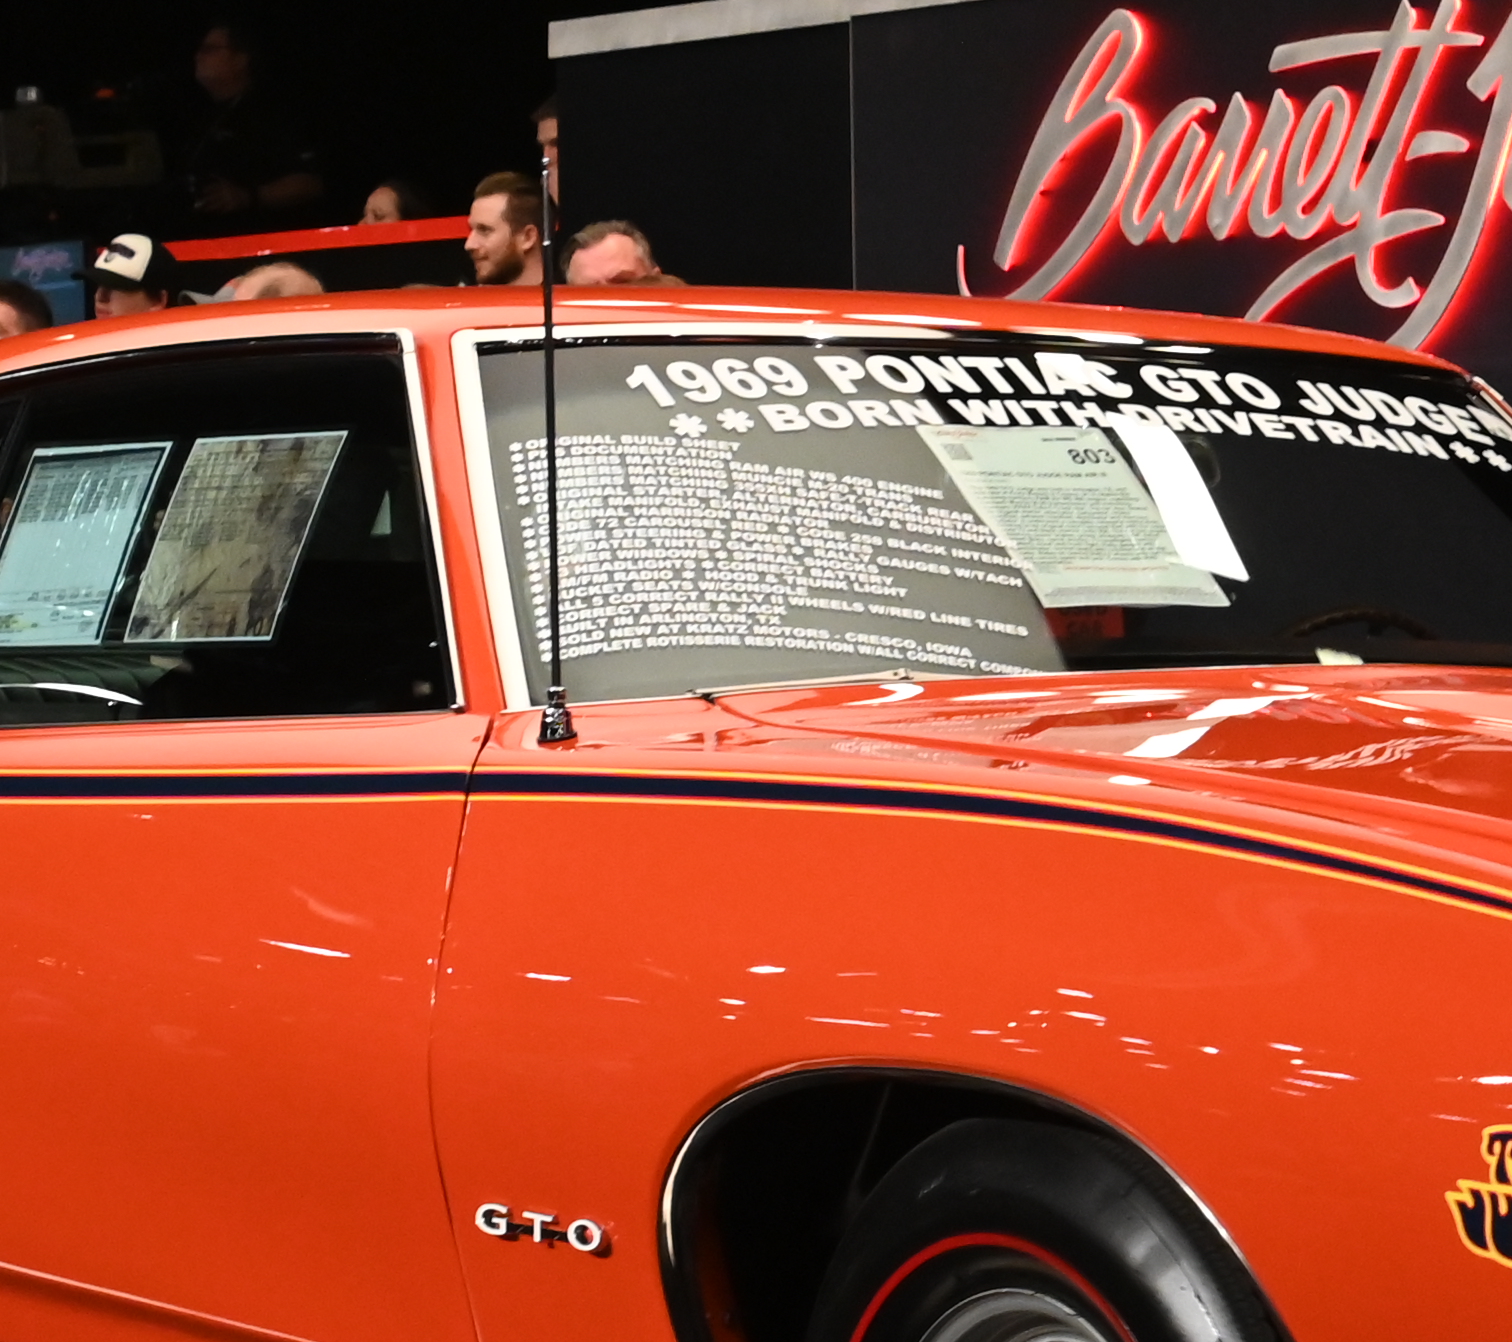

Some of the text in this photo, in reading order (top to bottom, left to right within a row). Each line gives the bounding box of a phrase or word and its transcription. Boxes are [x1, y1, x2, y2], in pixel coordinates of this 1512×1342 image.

[626, 356, 809, 408] 1969
[814, 354, 1133, 400] PONTIAC
[1139, 364, 1282, 410] GTO
[525, 435, 741, 452] ORGINAL BUILD SHEET
[758, 398, 1451, 460] BORN WITH DRIVETRAIN
[570, 445, 733, 460] DOCUMENTATION
[1067, 448, 1117, 465] 803
[626, 455, 724, 470] MATCHING
[729, 461, 770, 475] RAM
[774, 466, 805, 479] AIR
[841, 475, 873, 488] 400
[876, 480, 945, 500] ENGINE
[628, 465, 727, 480] MATCHING
[731, 471, 804, 488] MUNCIE
[852, 486, 914, 504] TRANS
[533, 486, 628, 504] OIGINAL
[867, 506, 990, 535] CARBURETOR
[629, 475, 729, 490] MATCHING
[927, 506, 974, 522] REAR
[536, 506, 830, 529] OIGINAL HARRISON RADIATOR
[709, 498, 792, 515] EXHAUST
[795, 507, 885, 527] MANIFOLD
[888, 519, 902, 530] &
[905, 521, 1019, 550] DISTRIBUTOR
[583, 538, 647, 552] DATED
[651, 538, 722, 550] TINTED
[726, 541, 788, 555] GLASS
[813, 547, 872, 563] RALLY
[876, 555, 951, 575] GAUGES
[595, 518, 620, 529] 72
[623, 516, 727, 530] CAROUSEL
[731, 521, 769, 533] RED
[796, 526, 848, 541] CODE
[886, 538, 948, 556] BLACK
[951, 548, 1035, 572] INTERIOR
[611, 528, 707, 540] STEERING
[711, 529, 726, 540] &
[730, 530, 796, 546] POWER
[799, 537, 874, 555] BRAKES
[574, 558, 697, 576] HEADLIGHTS
[717, 560, 805, 576] CORRECT
[809, 567, 894, 586] BATTERY
[615, 549, 709, 561] WINDOWS
[732, 551, 800, 566] SPIRAL
[803, 556, 880, 575] SHOCKS
[556, 569, 908, 598] M/FM RADIO HOOD & TRUNK LIGHT
[558, 582, 627, 601] UCKET
[631, 580, 694, 592] SEATS
[608, 591, 699, 605] CORRECT
[704, 591, 765, 604] RALLY
[787, 596, 866, 613] WHEELS
[929, 612, 973, 628] LINE
[974, 619, 1029, 637] TIRES
[613, 616, 635, 628] IN
[755, 615, 781, 626] TX
[648, 602, 711, 613] SPARE
[717, 602, 731, 613] &
[736, 603, 788, 616] JACK
[559, 638, 644, 661] COMPLETE
[646, 634, 742, 649] ROTISSERIE
[744, 636, 855, 654] RESTORATION
[906, 650, 977, 670] CORRECT
[609, 625, 652, 639] NEW
[657, 623, 682, 636] AT
[686, 623, 750, 636] KRATZ
[752, 624, 831, 640] MOTORS
[925, 642, 973, 658] IOWA
[474, 1203, 603, 1252] GTO
